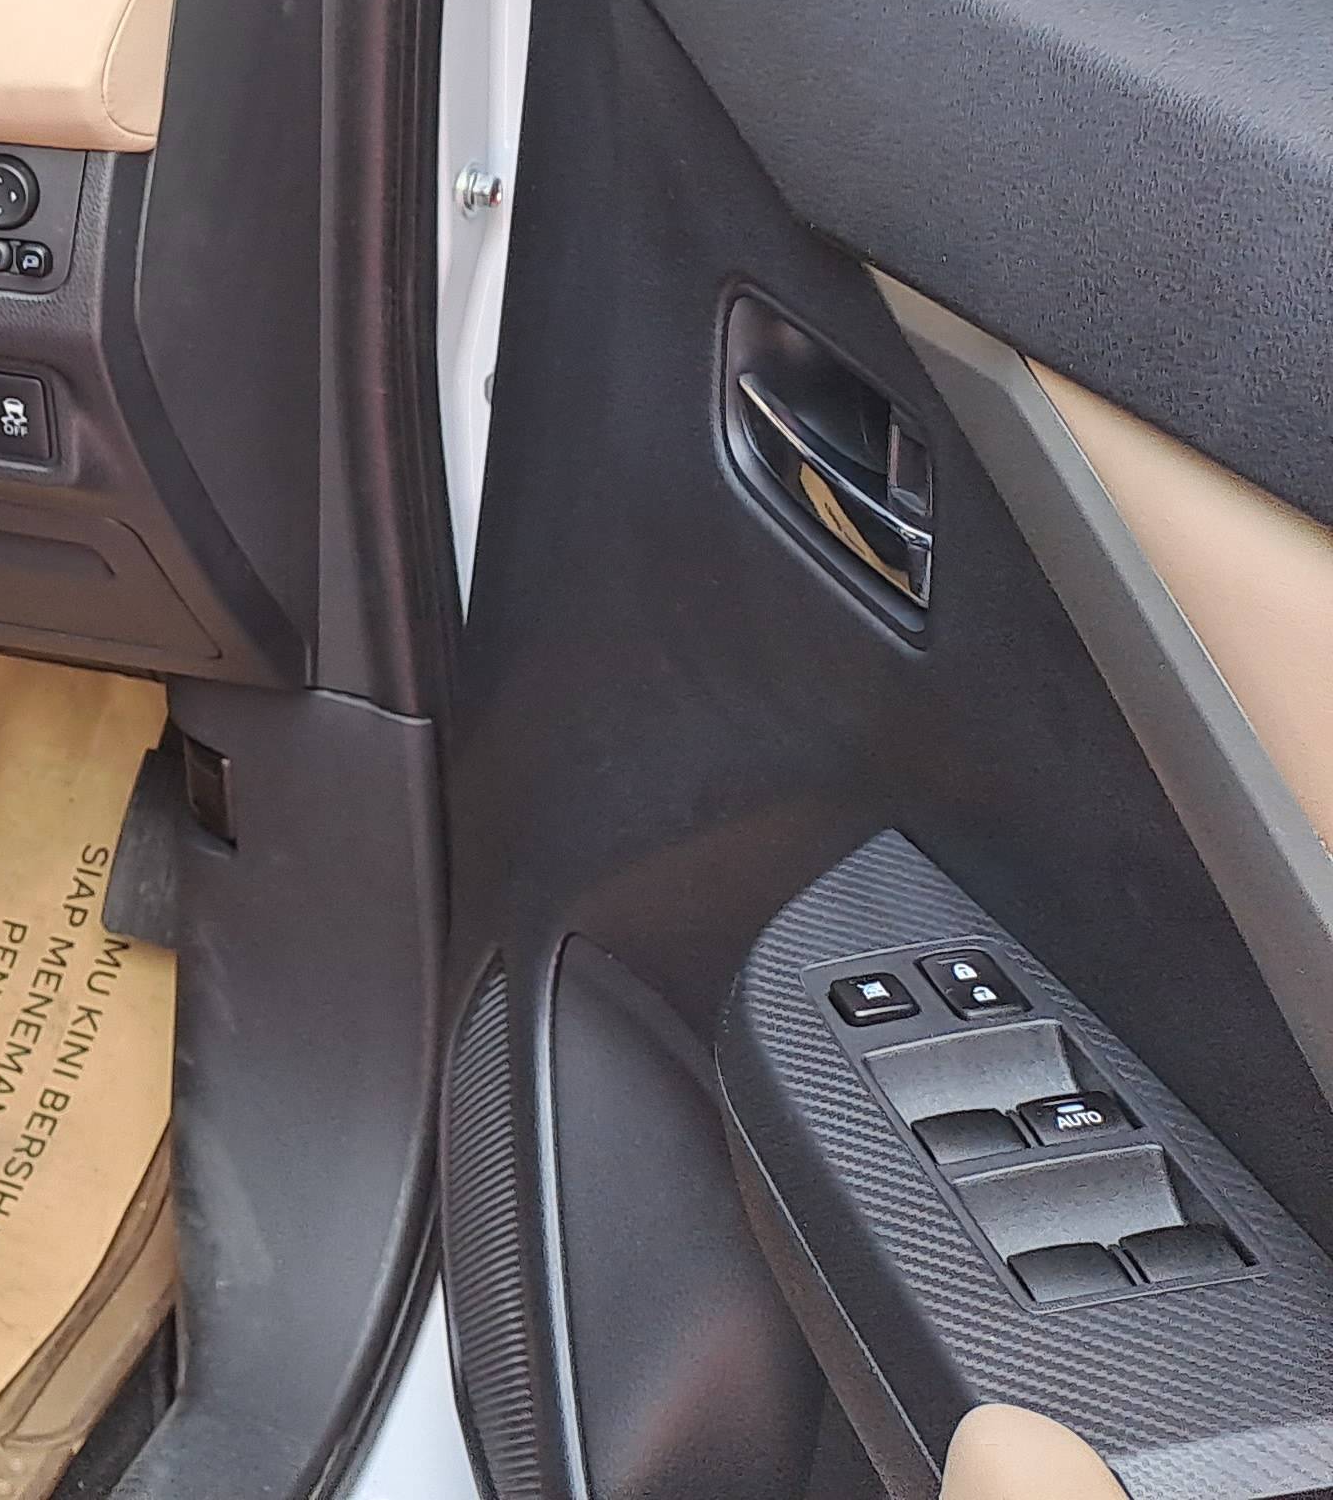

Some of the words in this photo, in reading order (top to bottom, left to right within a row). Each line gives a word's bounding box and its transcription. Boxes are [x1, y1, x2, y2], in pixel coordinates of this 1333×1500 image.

[3, 424, 29, 437] OFF
[62, 842, 109, 929] SIAP
[52, 1004, 103, 1080] KINI
[1056, 1110, 1103, 1131] AUTO
